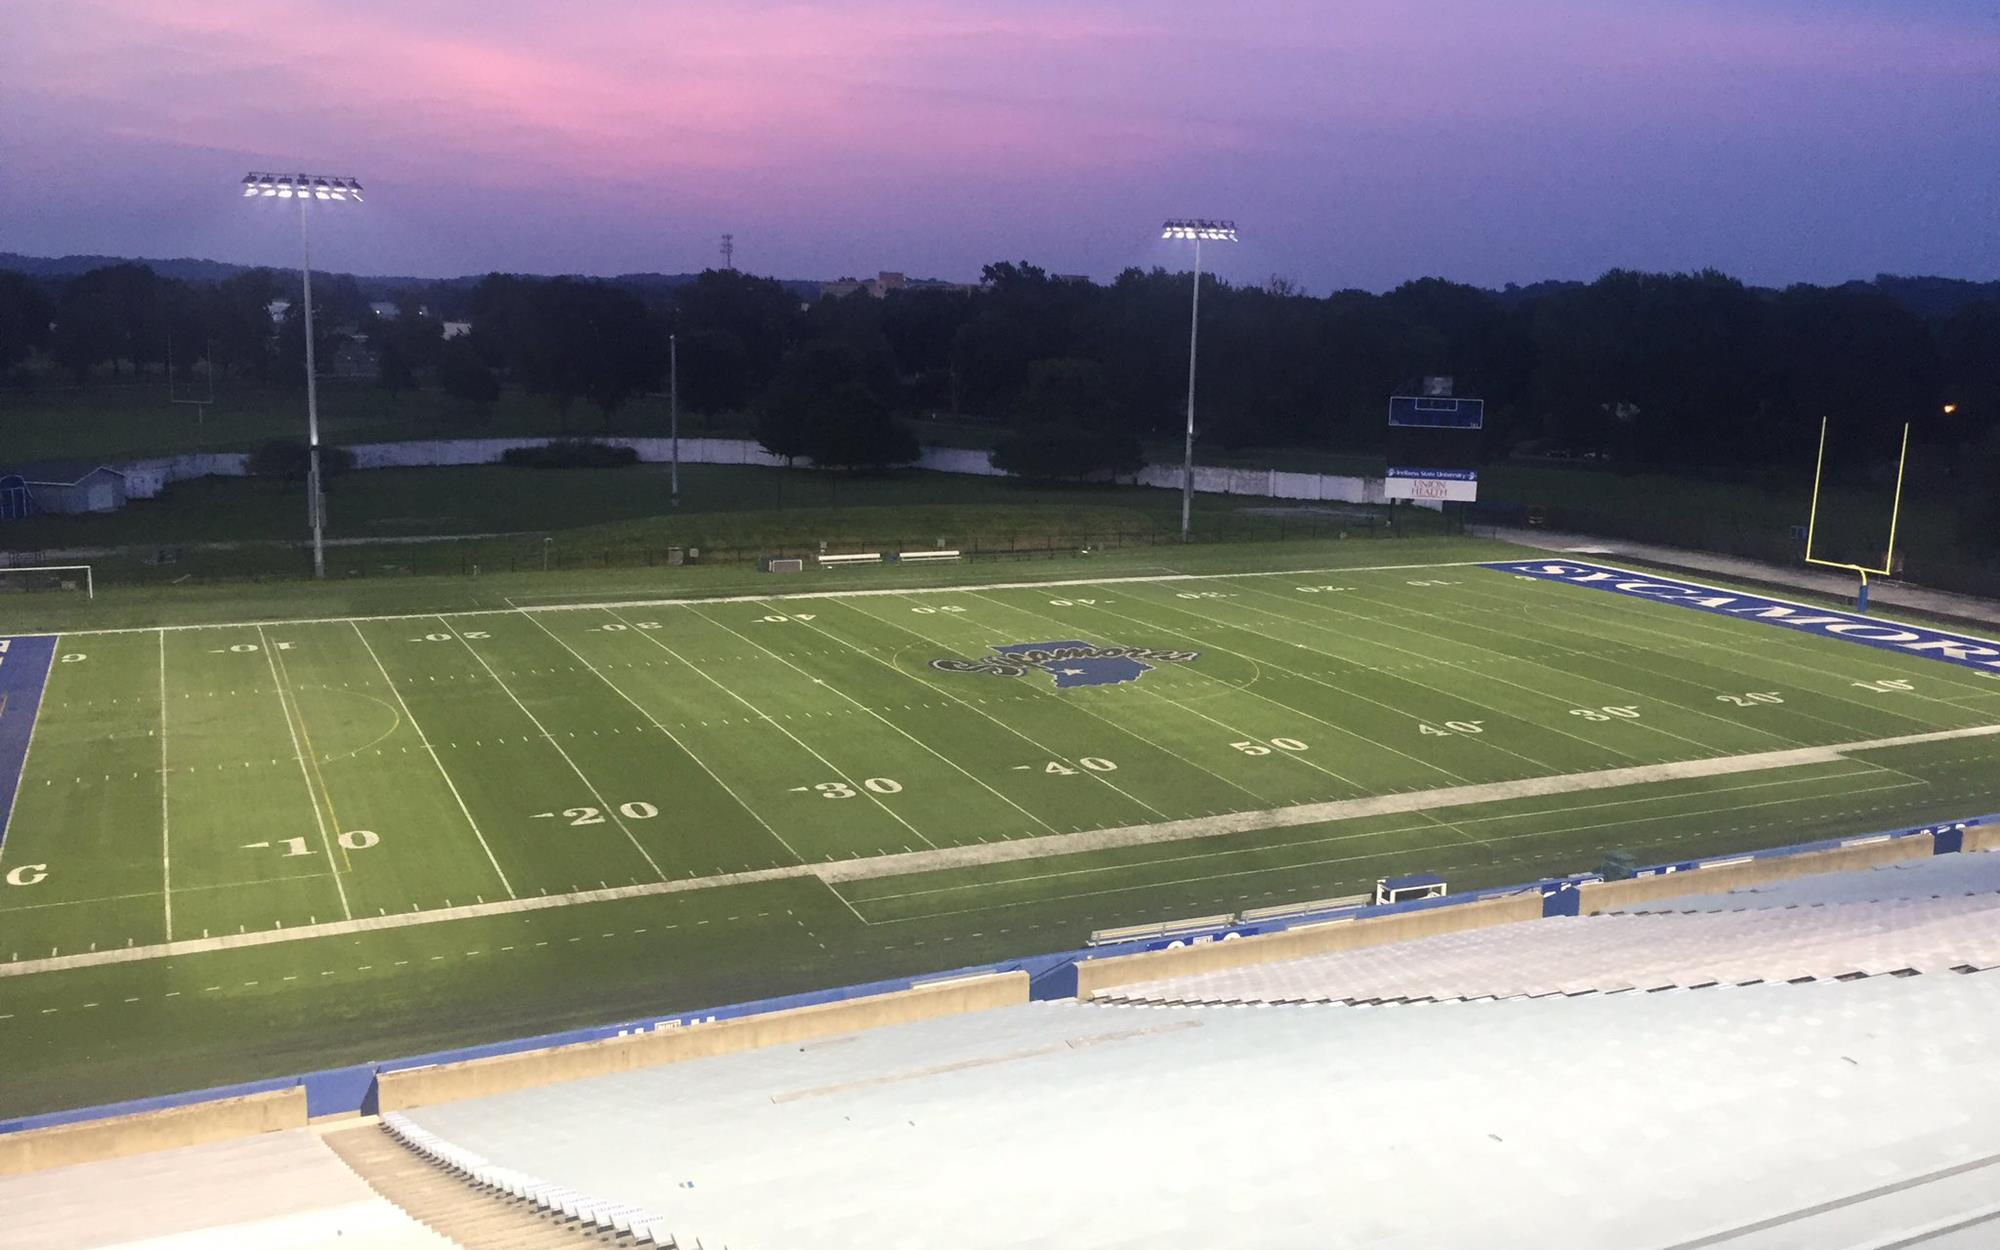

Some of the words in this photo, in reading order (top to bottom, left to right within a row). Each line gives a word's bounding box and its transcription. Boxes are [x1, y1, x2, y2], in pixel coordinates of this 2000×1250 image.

[1413, 480, 1446, 488] UNION
[1436, 471, 1466, 479] University
[1411, 488, 1448, 496] HEALTH
[1716, 692, 1784, 707] 20
[1569, 706, 1641, 721] 30
[1418, 720, 1484, 736] 40
[1228, 736, 1310, 756] 50
[1045, 756, 1118, 776] 40
[814, 777, 903, 799] 30
[562, 801, 660, 826] 20
[276, 830, 380, 857] 10
[6, 863, 48, 886] G
